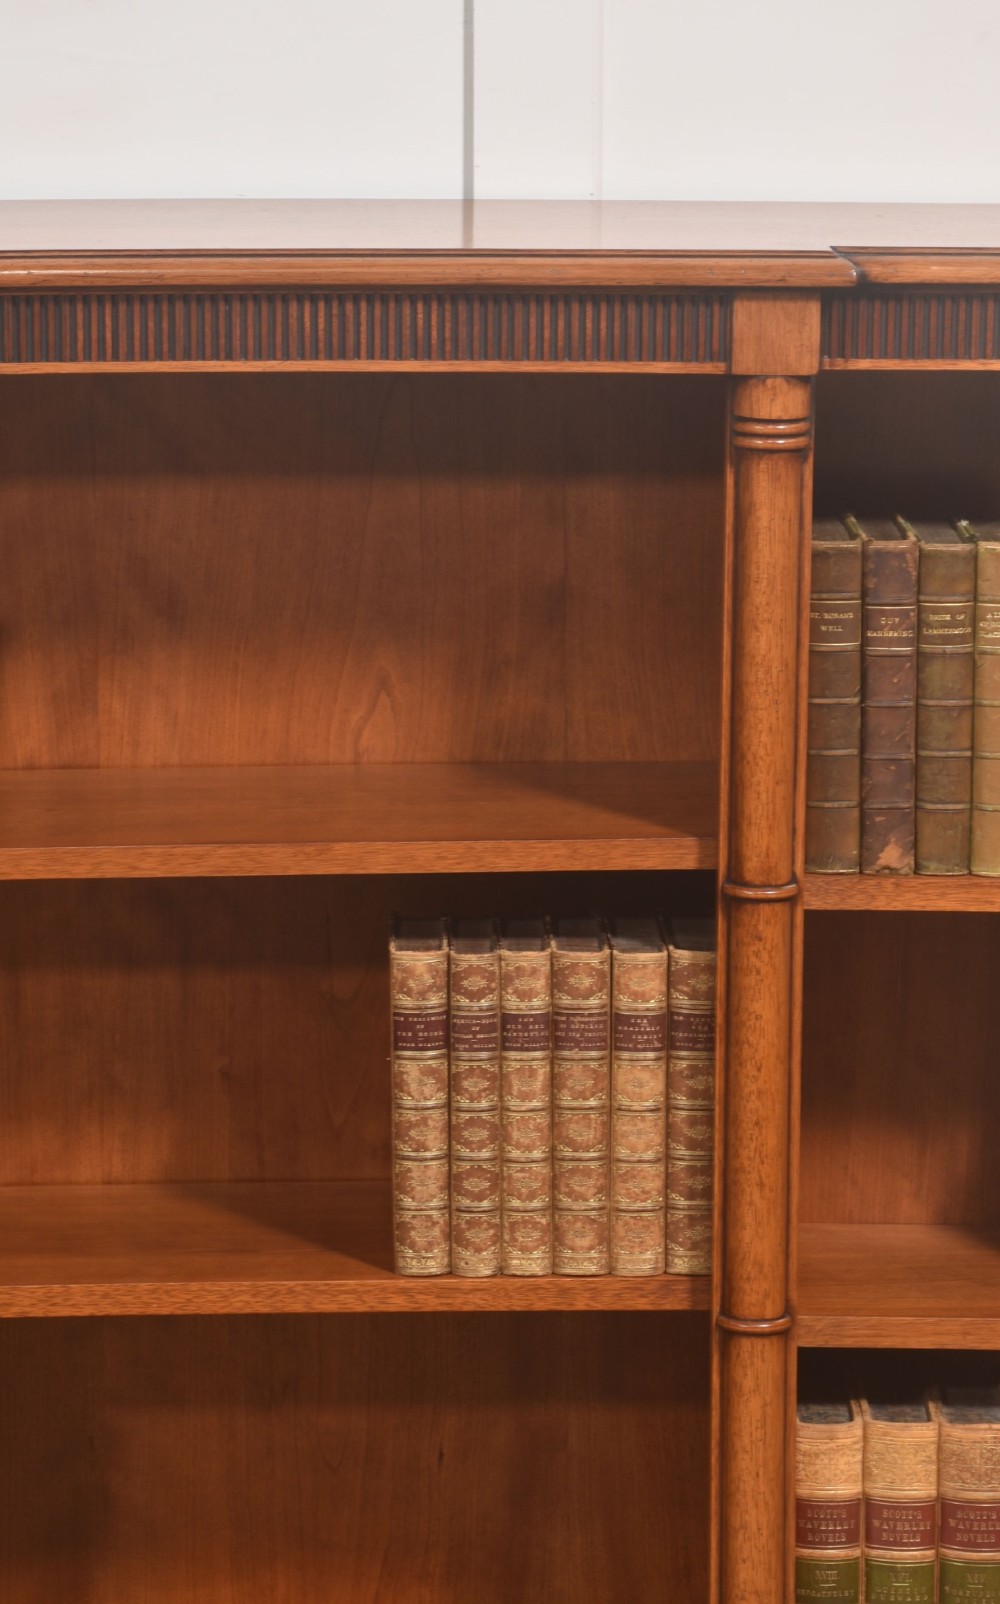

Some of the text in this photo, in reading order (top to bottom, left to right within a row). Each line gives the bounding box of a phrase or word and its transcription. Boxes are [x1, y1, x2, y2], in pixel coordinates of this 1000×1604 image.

[807, 1509, 848, 1518] SCOTT'S
[882, 1509, 923, 1519] SCOTT'S
[956, 1510, 998, 1519] SCOTT'S
[799, 1519, 856, 1530] WAVERLEY
[872, 1519, 931, 1530] WAVERLEY
[807, 1533, 847, 1543] NOVELS
[881, 1532, 921, 1542] NOVELS
[956, 1532, 996, 1542] NOVELS
